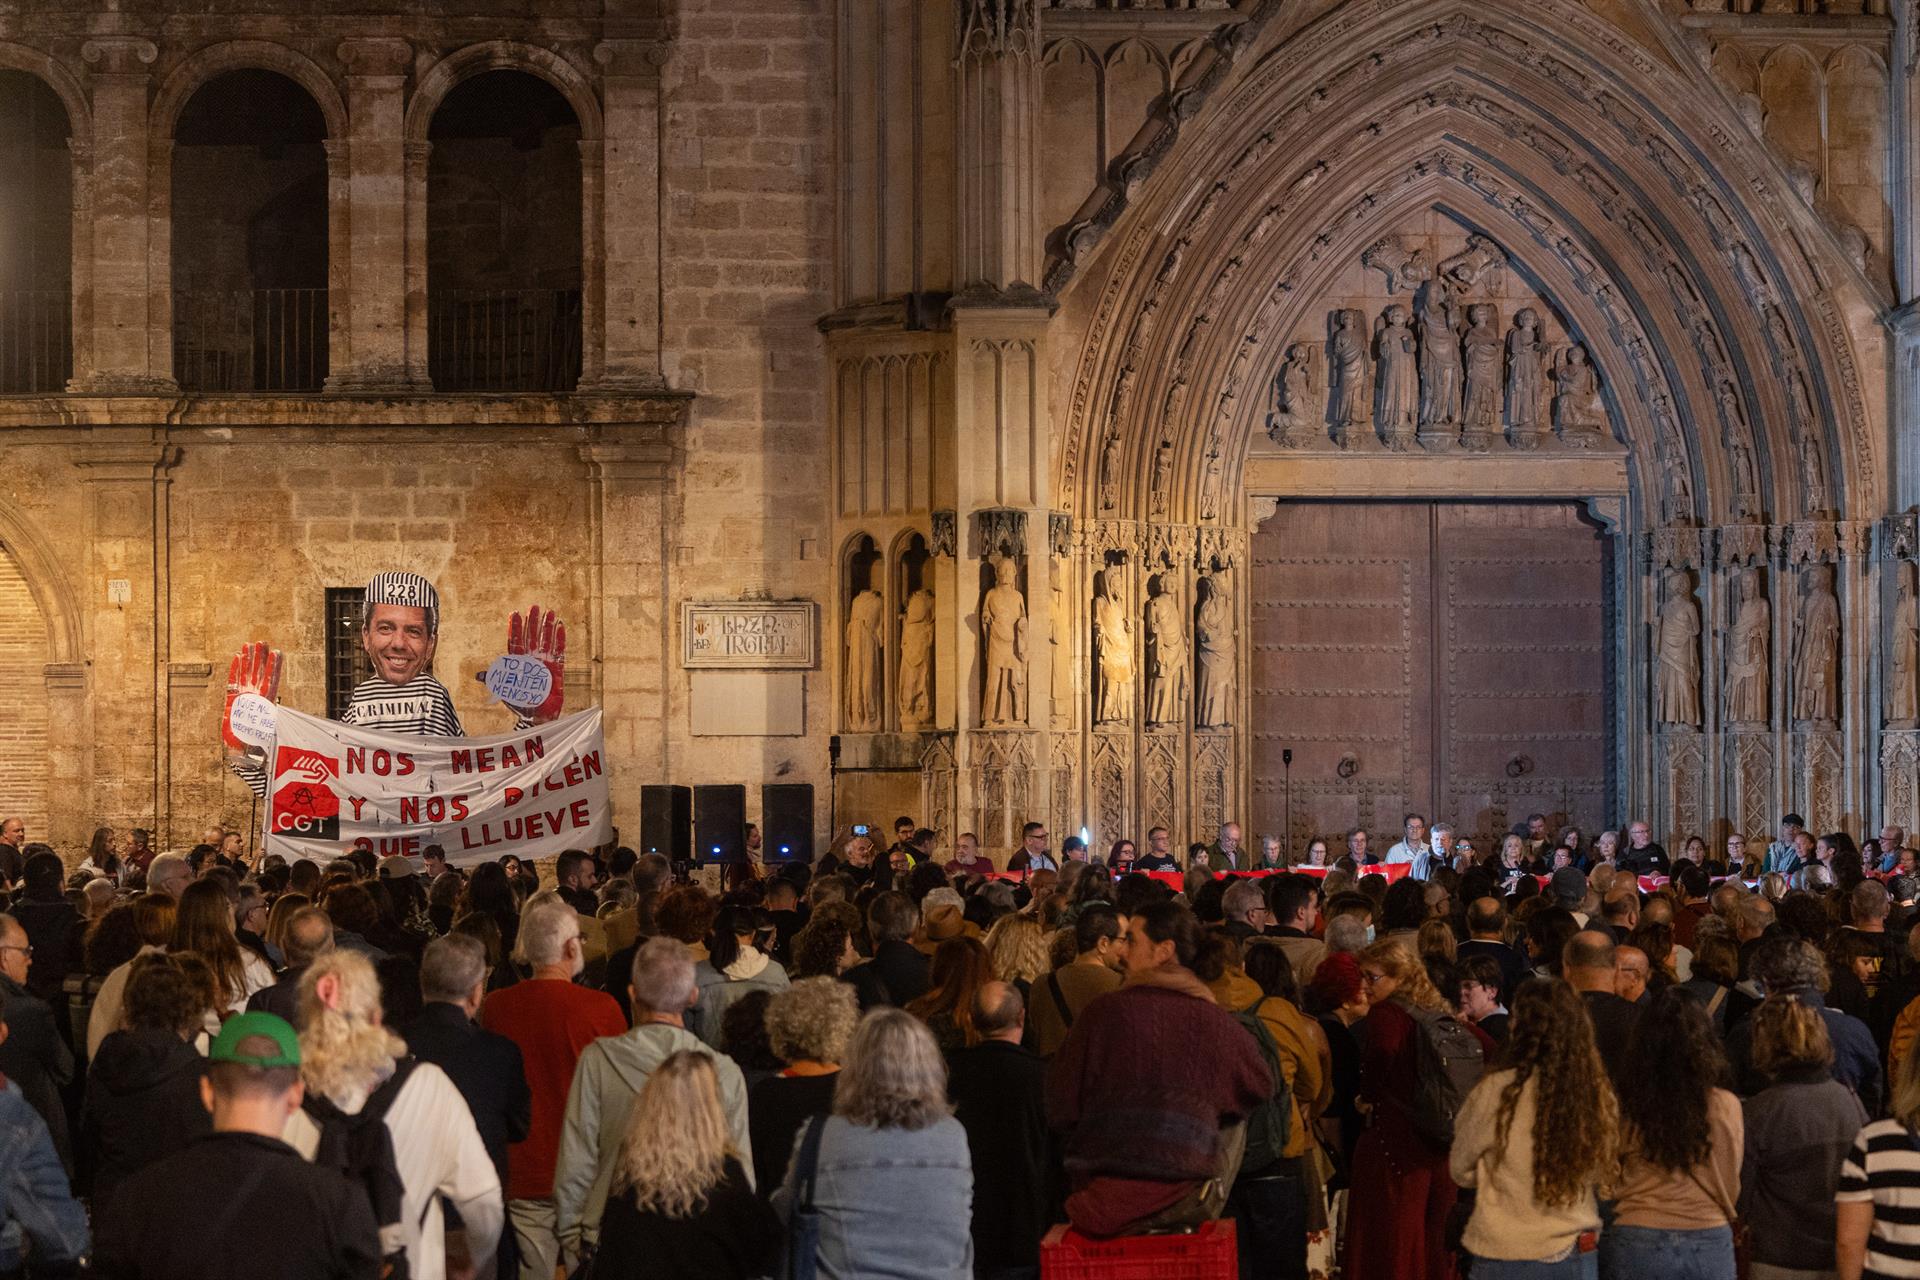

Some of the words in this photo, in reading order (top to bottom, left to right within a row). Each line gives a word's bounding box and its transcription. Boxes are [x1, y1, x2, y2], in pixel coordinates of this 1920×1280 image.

[387, 584, 417, 600] 228
[490, 669, 548, 691] MIENTEN
[492, 684, 530, 702] MENOS
[528, 693, 544, 706] YO
[347, 747, 415, 776] NOS
[451, 735, 545, 774] MEAN
[348, 796, 367, 821] Y
[401, 794, 469, 824] NOS
[277, 812, 328, 834] CGT
[461, 798, 590, 850] LLUEVE
